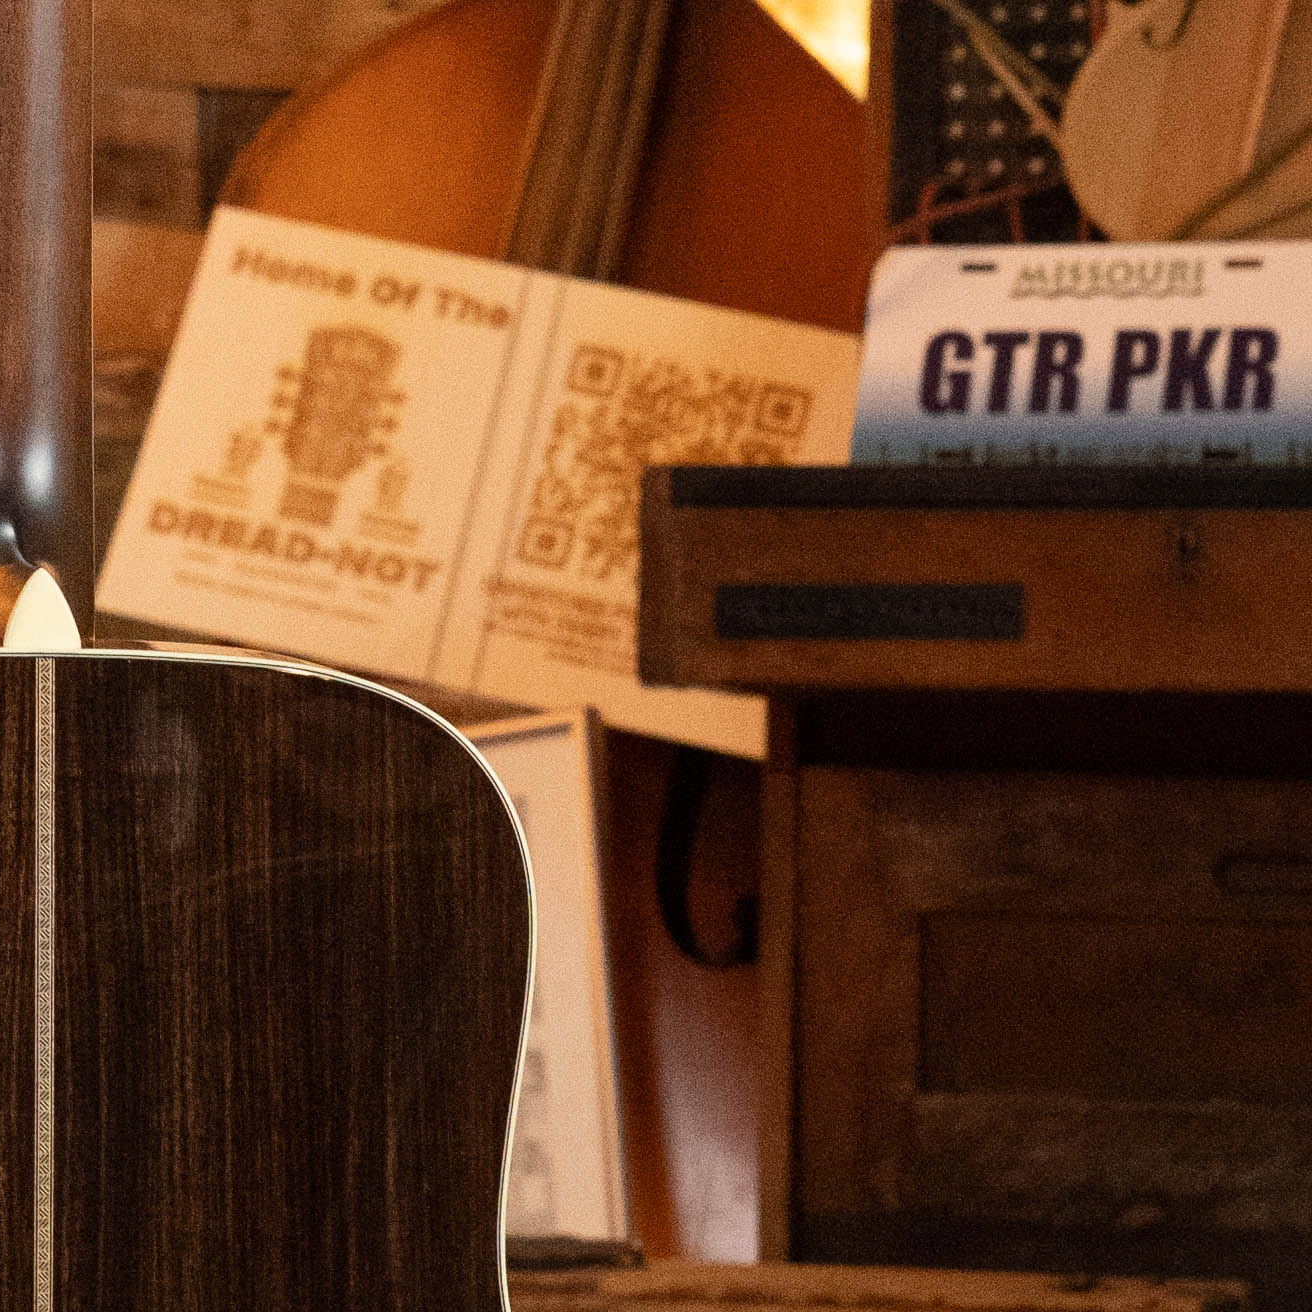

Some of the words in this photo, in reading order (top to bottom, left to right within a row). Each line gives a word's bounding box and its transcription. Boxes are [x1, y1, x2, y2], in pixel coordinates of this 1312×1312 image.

[230, 245, 359, 295] Home
[369, 276, 417, 308] Of
[434, 287, 513, 329] The
[1017, 257, 1206, 290] MISSOURI
[919, 329, 1085, 415] GTR
[1106, 328, 1279, 413] PKR
[148, 500, 444, 589] DREAD-NOT
